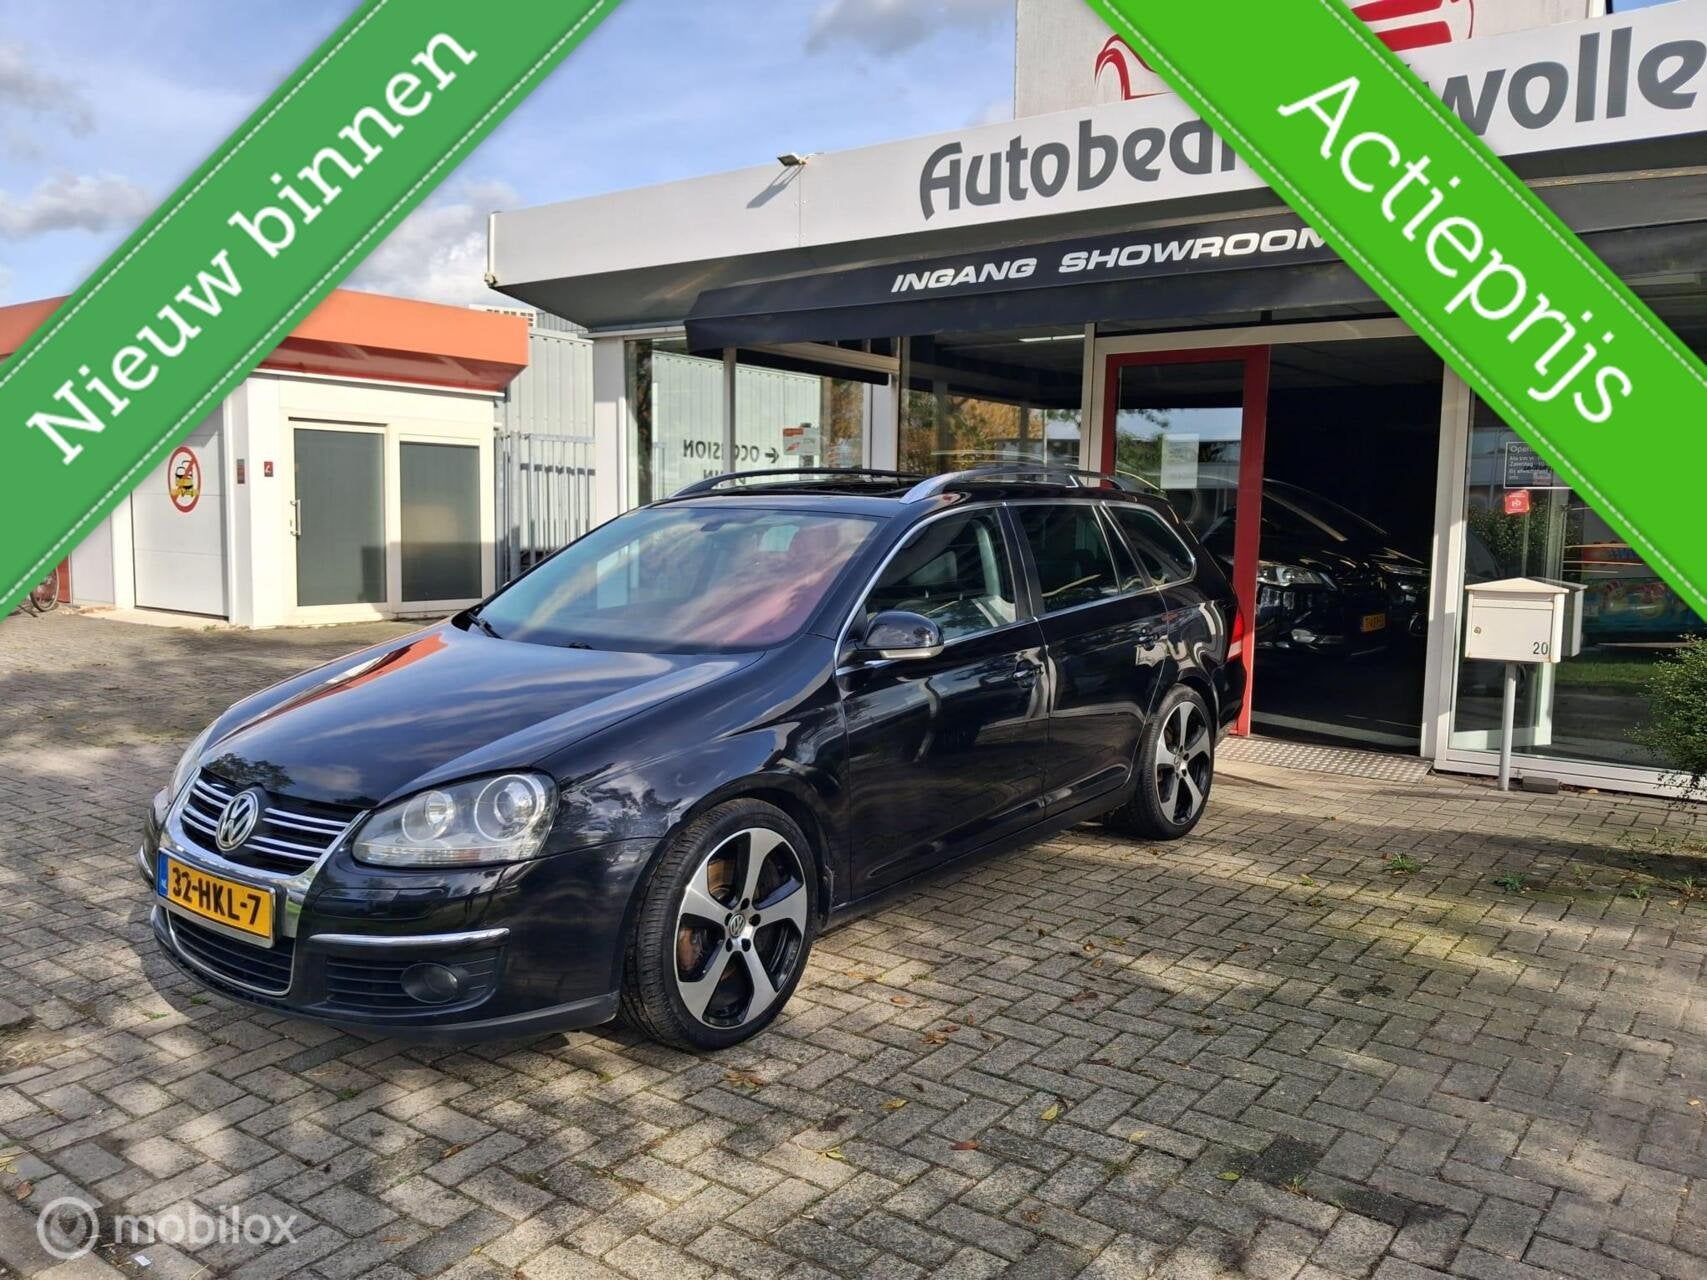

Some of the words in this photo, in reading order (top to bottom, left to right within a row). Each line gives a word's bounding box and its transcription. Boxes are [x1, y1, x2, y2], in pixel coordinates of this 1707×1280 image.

[1404, 26, 1707, 136] wolle
[891, 257, 1037, 293] INGANG
[1533, 641, 1549, 655] 20
[172, 866, 262, 926] 32-HKL-7
